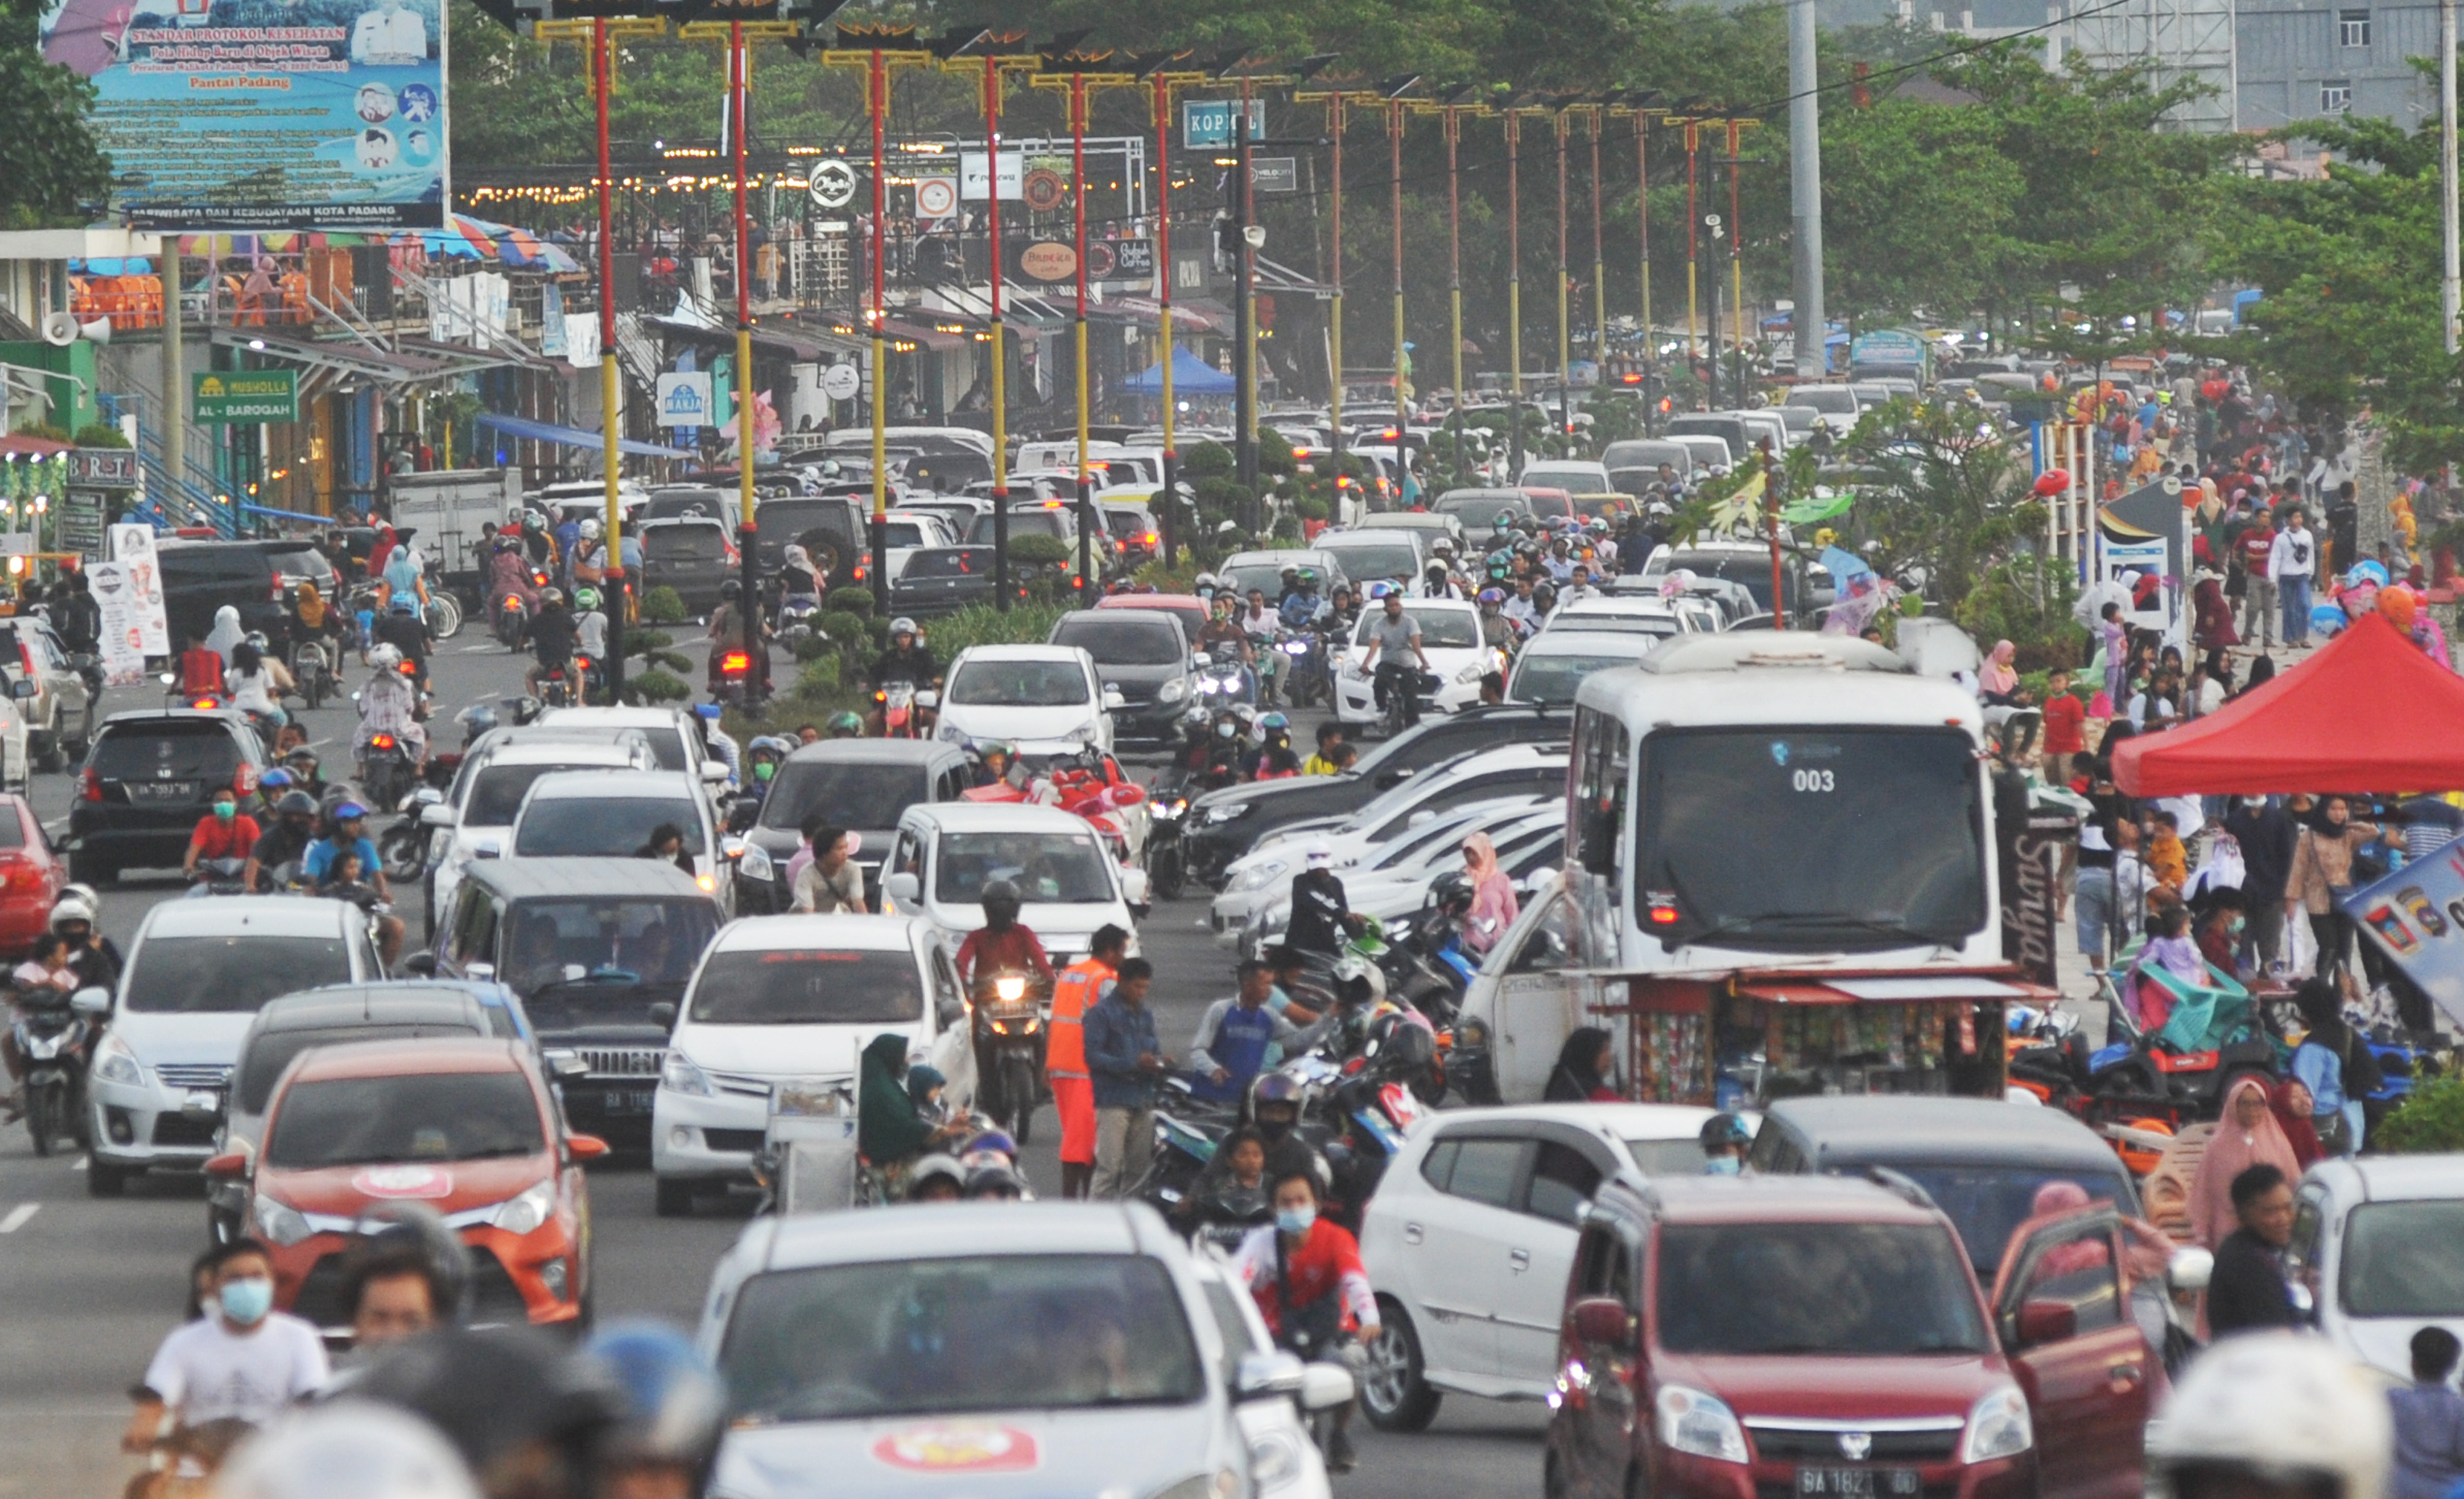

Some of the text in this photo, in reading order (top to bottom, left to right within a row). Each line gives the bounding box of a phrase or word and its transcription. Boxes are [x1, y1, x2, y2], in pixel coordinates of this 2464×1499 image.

[132, 28, 345, 41] STANDAR PROTOKOL KESEHATAN
[152, 44, 329, 60] Pola Hidup Baru di Objek Wisata
[190, 76, 289, 89] Pantai Padang
[1191, 113, 1257, 131] KOPML
[206, 208, 229, 216] DAN
[233, 207, 310, 216] KEBUDAYAAN
[314, 206, 345, 215] KOTA
[348, 206, 395, 215] PADANG
[230, 381, 289, 393] MUSHOLLA
[198, 406, 214, 416] AL
[225, 405, 291, 416] BAROQAH
[666, 398, 702, 412] MANJA
[1793, 769, 1835, 792] 003
[2001, 834, 2050, 965] Surya
[1803, 1471, 1825, 1493] BA
